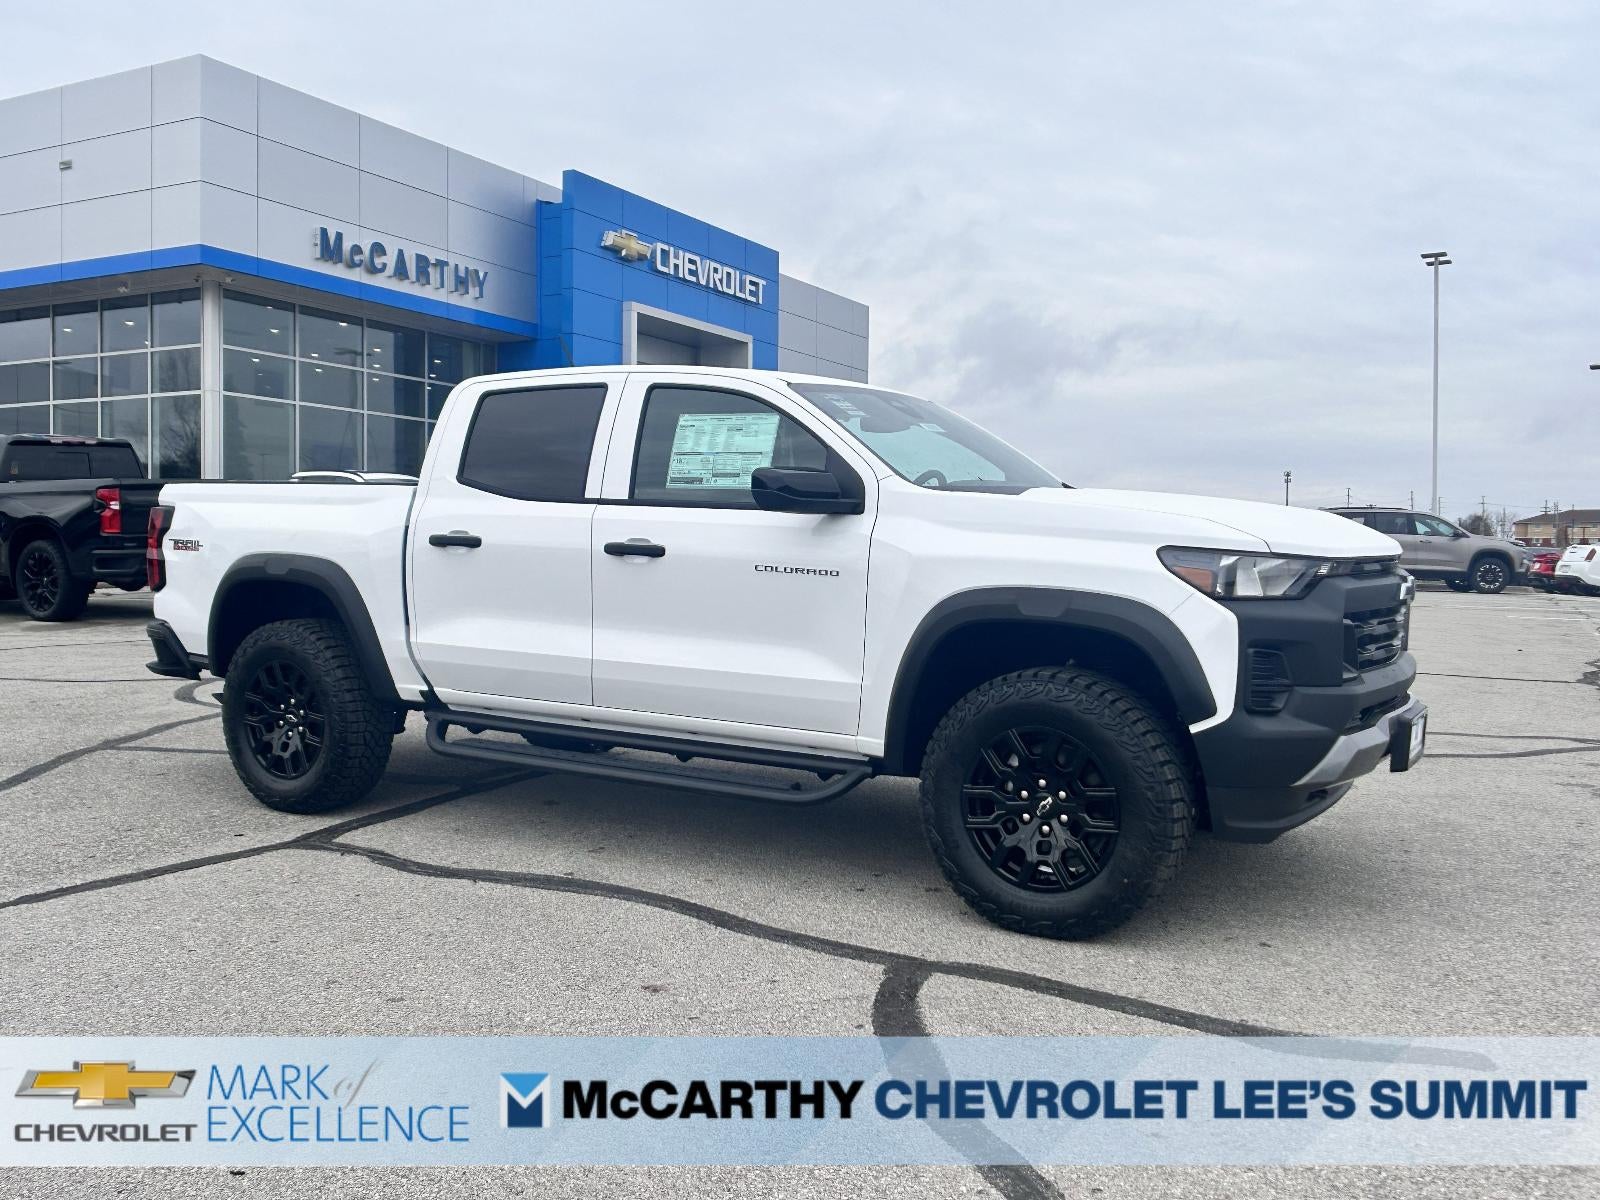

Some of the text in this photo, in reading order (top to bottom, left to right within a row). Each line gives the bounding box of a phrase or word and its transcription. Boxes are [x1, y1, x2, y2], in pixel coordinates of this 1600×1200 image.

[313, 226, 488, 299] McCARTHY
[654, 242, 766, 305] CHEVROLET
[754, 564, 840, 577] COLORADO
